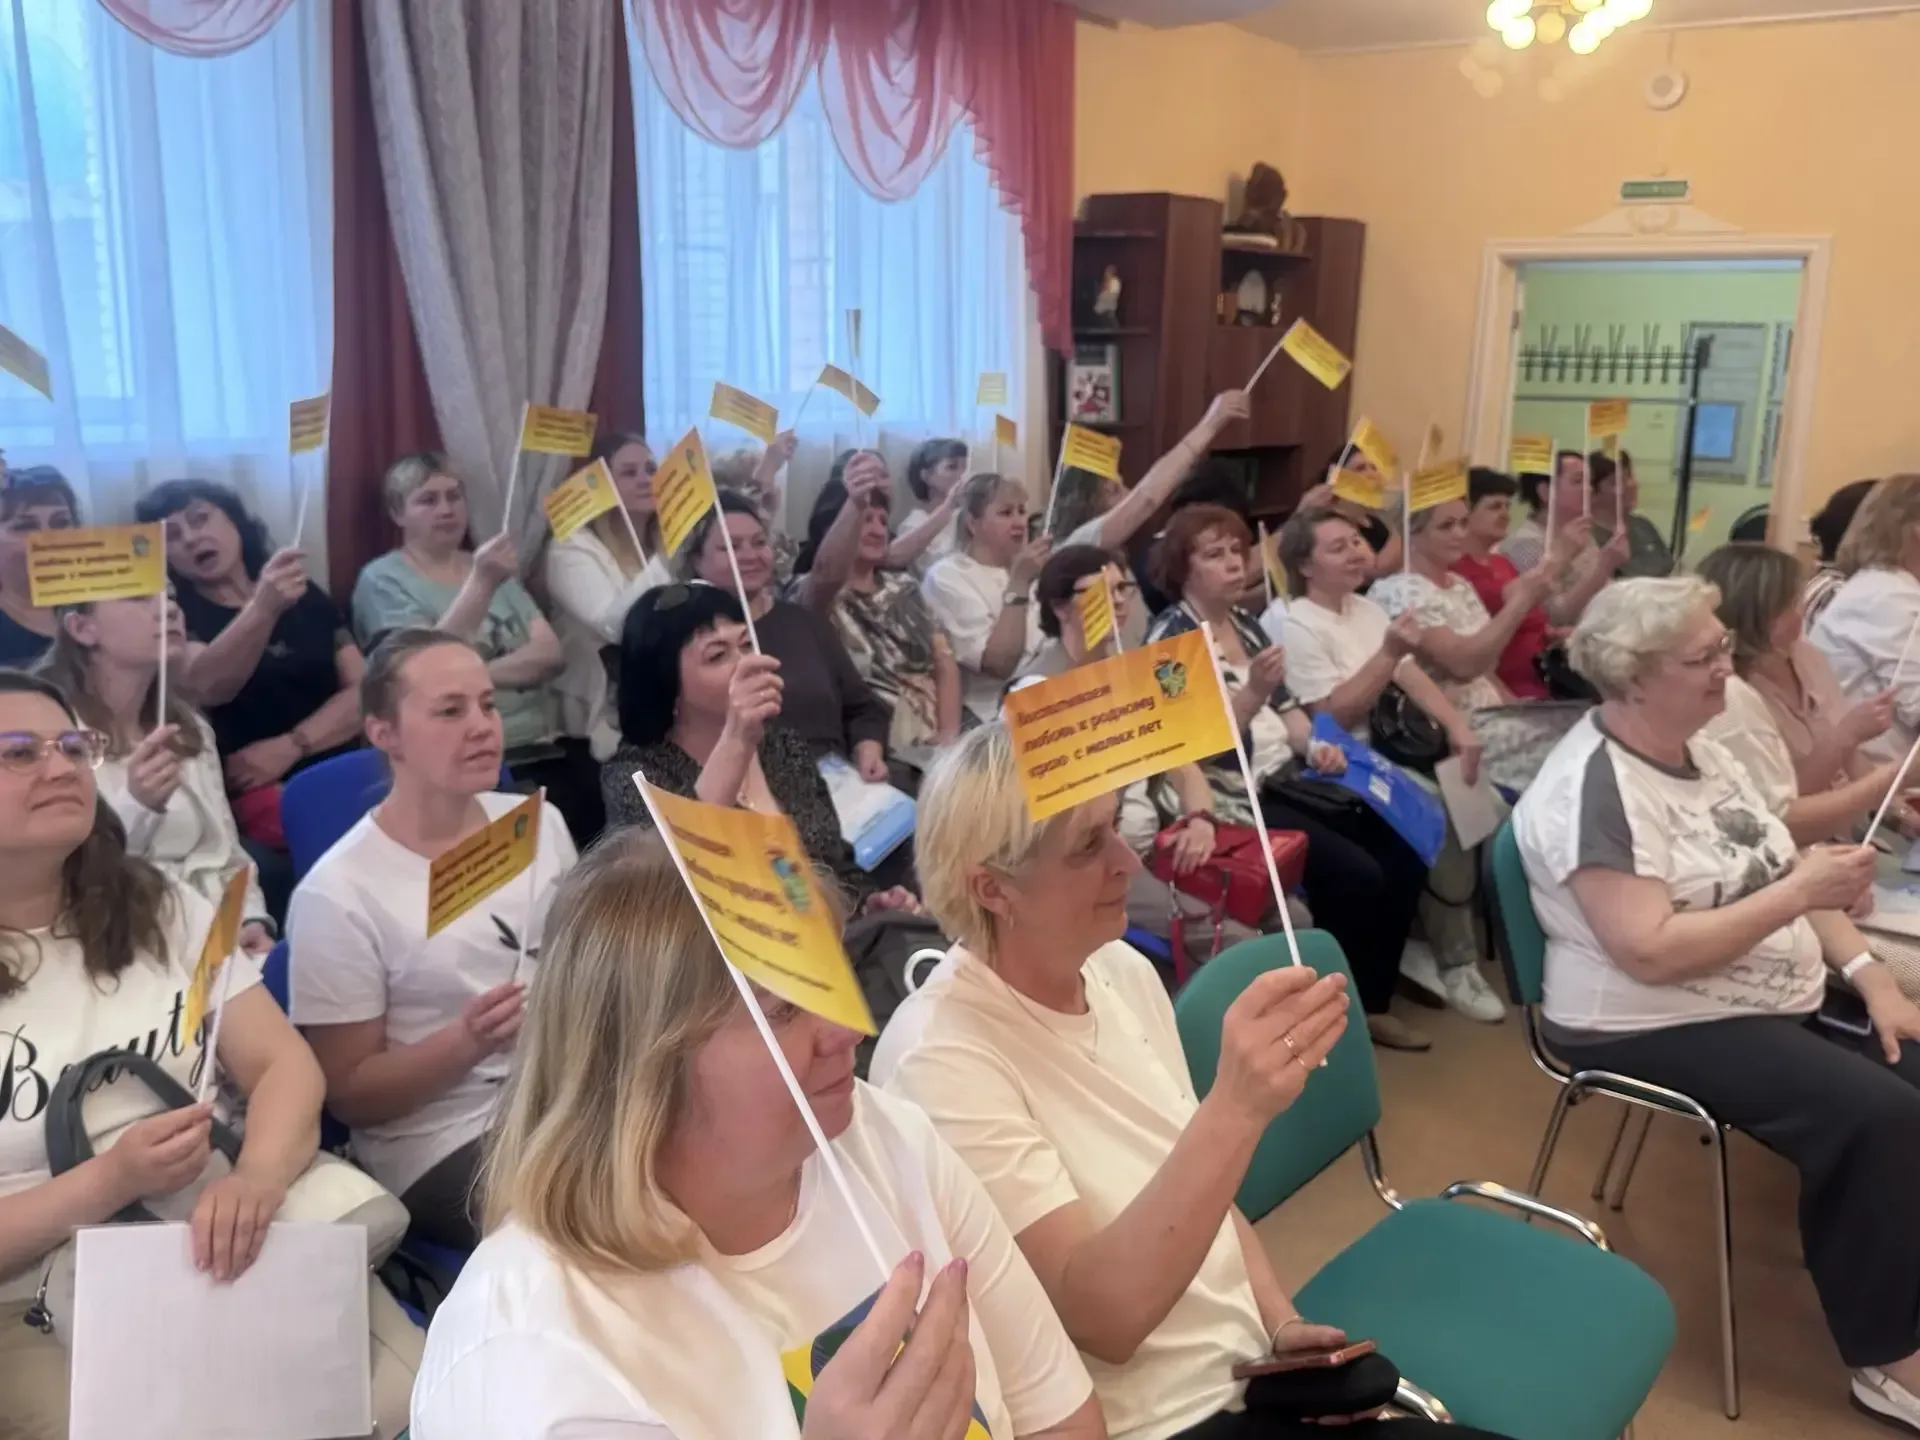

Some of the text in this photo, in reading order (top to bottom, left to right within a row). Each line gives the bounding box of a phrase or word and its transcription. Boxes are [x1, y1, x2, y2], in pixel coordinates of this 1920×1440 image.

[1073, 748, 1085, 760] с
[1138, 719, 1164, 737] лет
[0, 990, 217, 1122] Bauty
